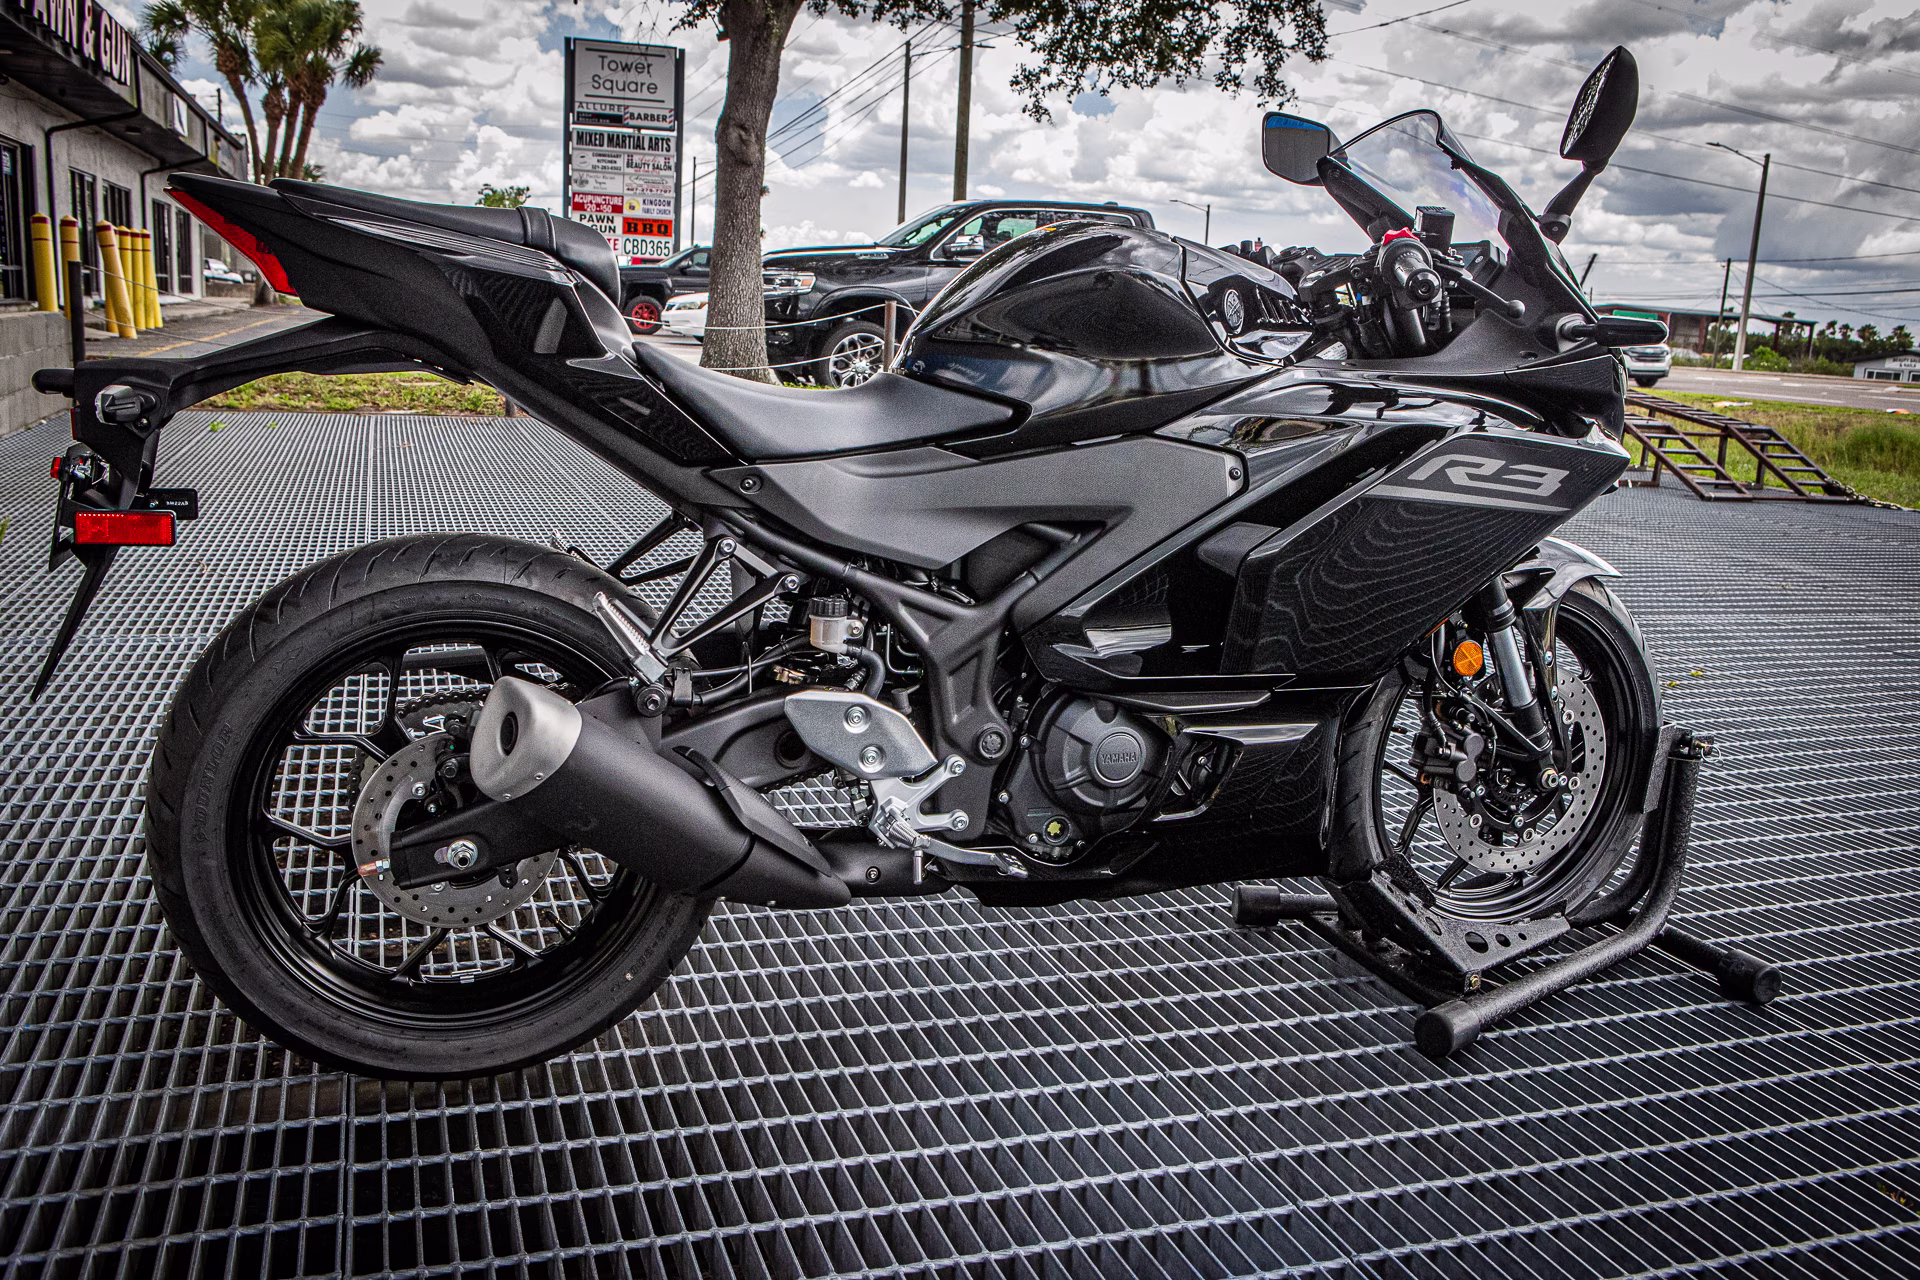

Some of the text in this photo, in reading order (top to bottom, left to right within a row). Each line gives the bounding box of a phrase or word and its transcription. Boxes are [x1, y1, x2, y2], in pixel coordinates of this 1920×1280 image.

[82, 0, 96, 61] &
[100, 9, 130, 87] GUN
[598, 55, 653, 75] Tower
[591, 74, 658, 95] Square
[577, 102, 624, 113] ALLURE
[629, 112, 668, 123] BARBER
[576, 131, 671, 152] MIXED MARTIAL ARTS
[626, 161, 650, 169] BEAUTY
[651, 163, 672, 172] SALON
[574, 194, 623, 206] ACUPUNCTURE
[642, 198, 671, 207] KINGDOM
[579, 213, 614, 224] PAWN
[591, 224, 617, 234] GUN
[624, 237, 671, 257] CBD365
[1407, 453, 1570, 497] R3
[1101, 751, 1138, 765] YAMAHA
